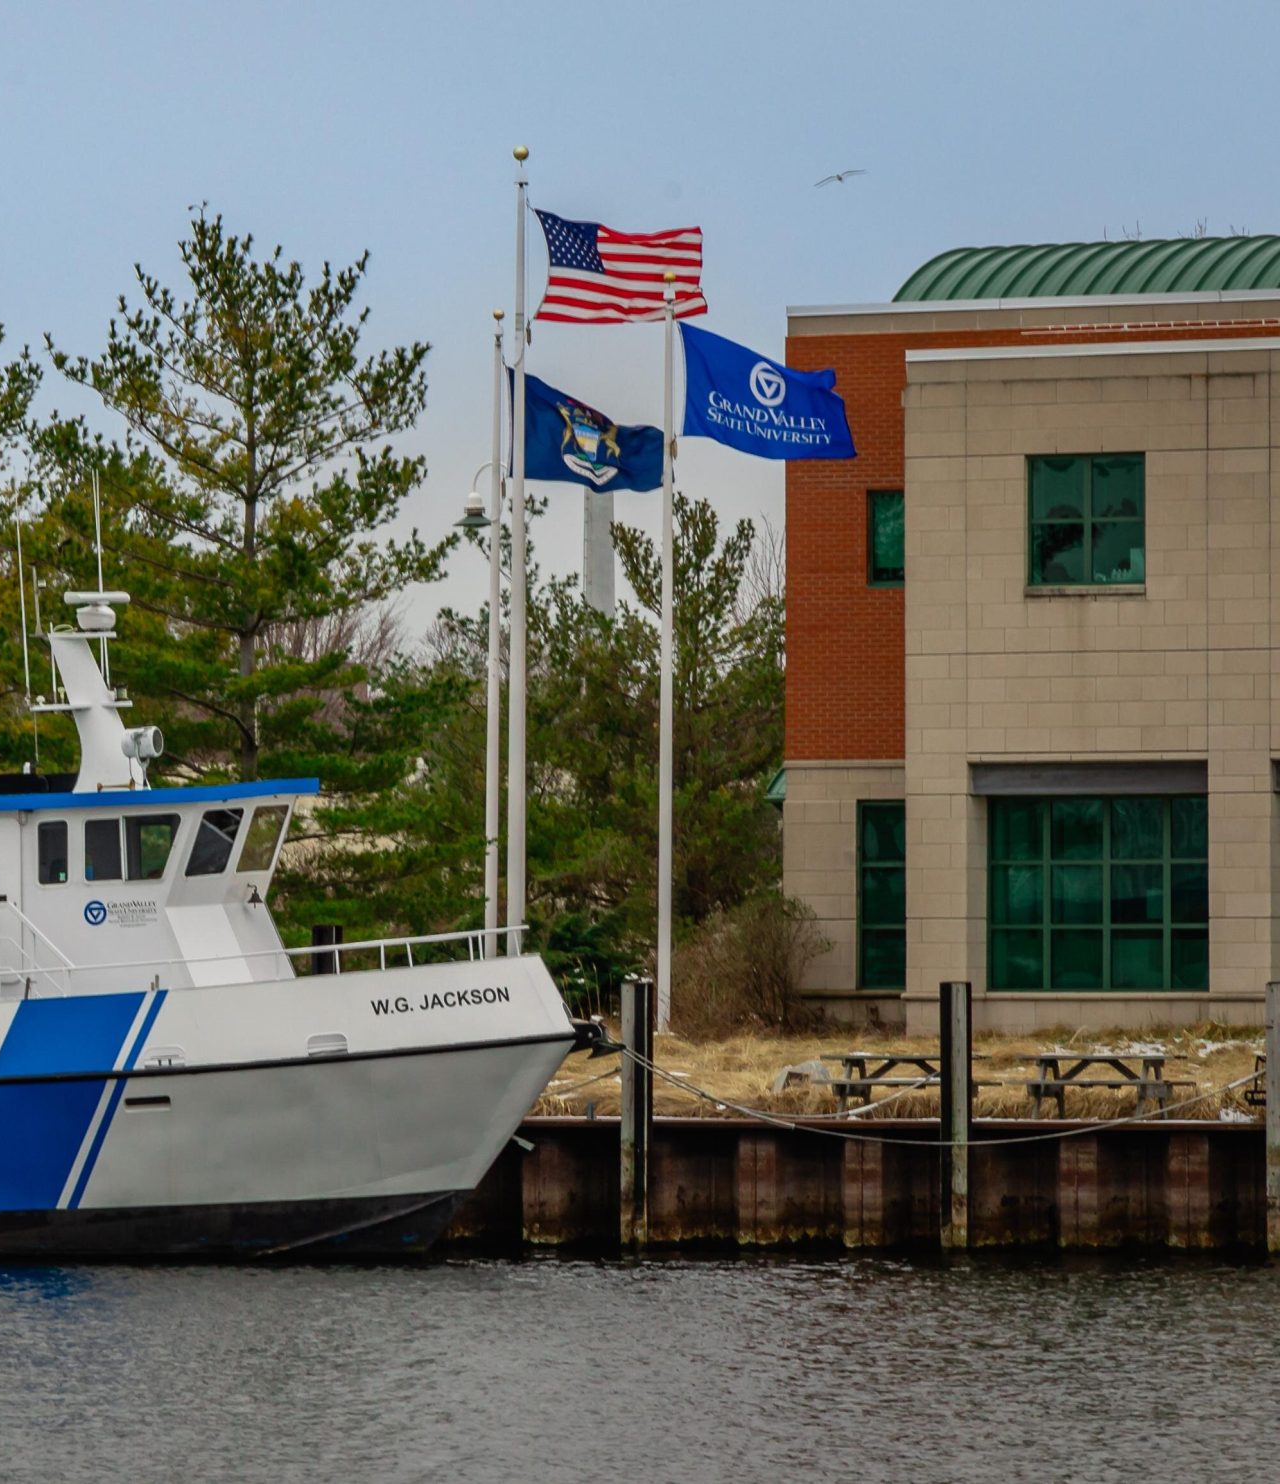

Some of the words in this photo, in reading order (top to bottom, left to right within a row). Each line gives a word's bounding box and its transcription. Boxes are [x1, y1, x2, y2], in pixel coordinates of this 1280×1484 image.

[706, 407, 745, 431] STATE
[745, 421, 832, 444] UNIVERSITY
[708, 391, 769, 423] GRAND
[768, 408, 826, 431] VALLEY
[371, 997, 414, 1015] W.G.
[419, 987, 510, 1010] JACKSON
